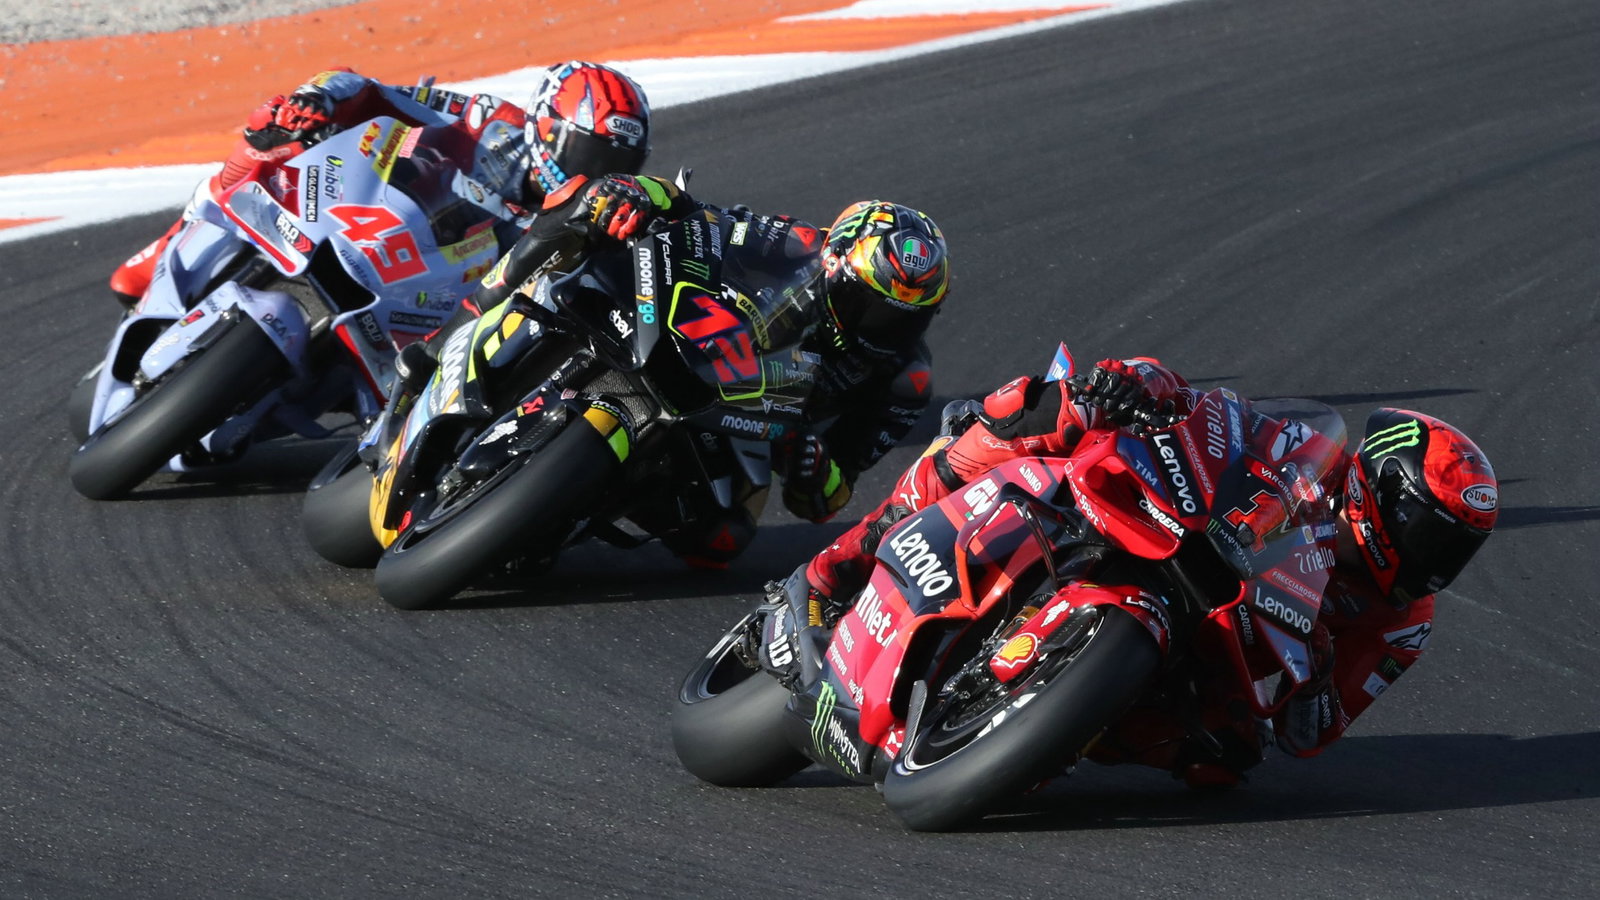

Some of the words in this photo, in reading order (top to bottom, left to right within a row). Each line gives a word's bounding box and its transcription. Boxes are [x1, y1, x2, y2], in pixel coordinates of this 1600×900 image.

[325, 154, 345, 200] Unibat
[276, 212, 299, 240] BOLD
[322, 203, 431, 287] 49
[690, 219, 704, 259] MONSTER
[662, 243, 673, 286] CUPRA
[610, 308, 633, 340] ebay
[676, 294, 761, 385] 12
[739, 298, 770, 347] BARDAHL
[1052, 363, 1066, 380] TIM
[1135, 459, 1159, 487] TIM
[1153, 433, 1197, 514] Lenovo
[1180, 424, 1215, 494] FRECCIAROSSA
[1079, 494, 1100, 527] Sport
[1138, 498, 1186, 538] CARRERA
[1222, 489, 1290, 557] 1
[889, 516, 954, 598] Lenovo
[1271, 570, 1321, 604] FRECCIAROSSA
[1254, 586, 1313, 635] Lenovo
[828, 714, 861, 774] MONSTER
